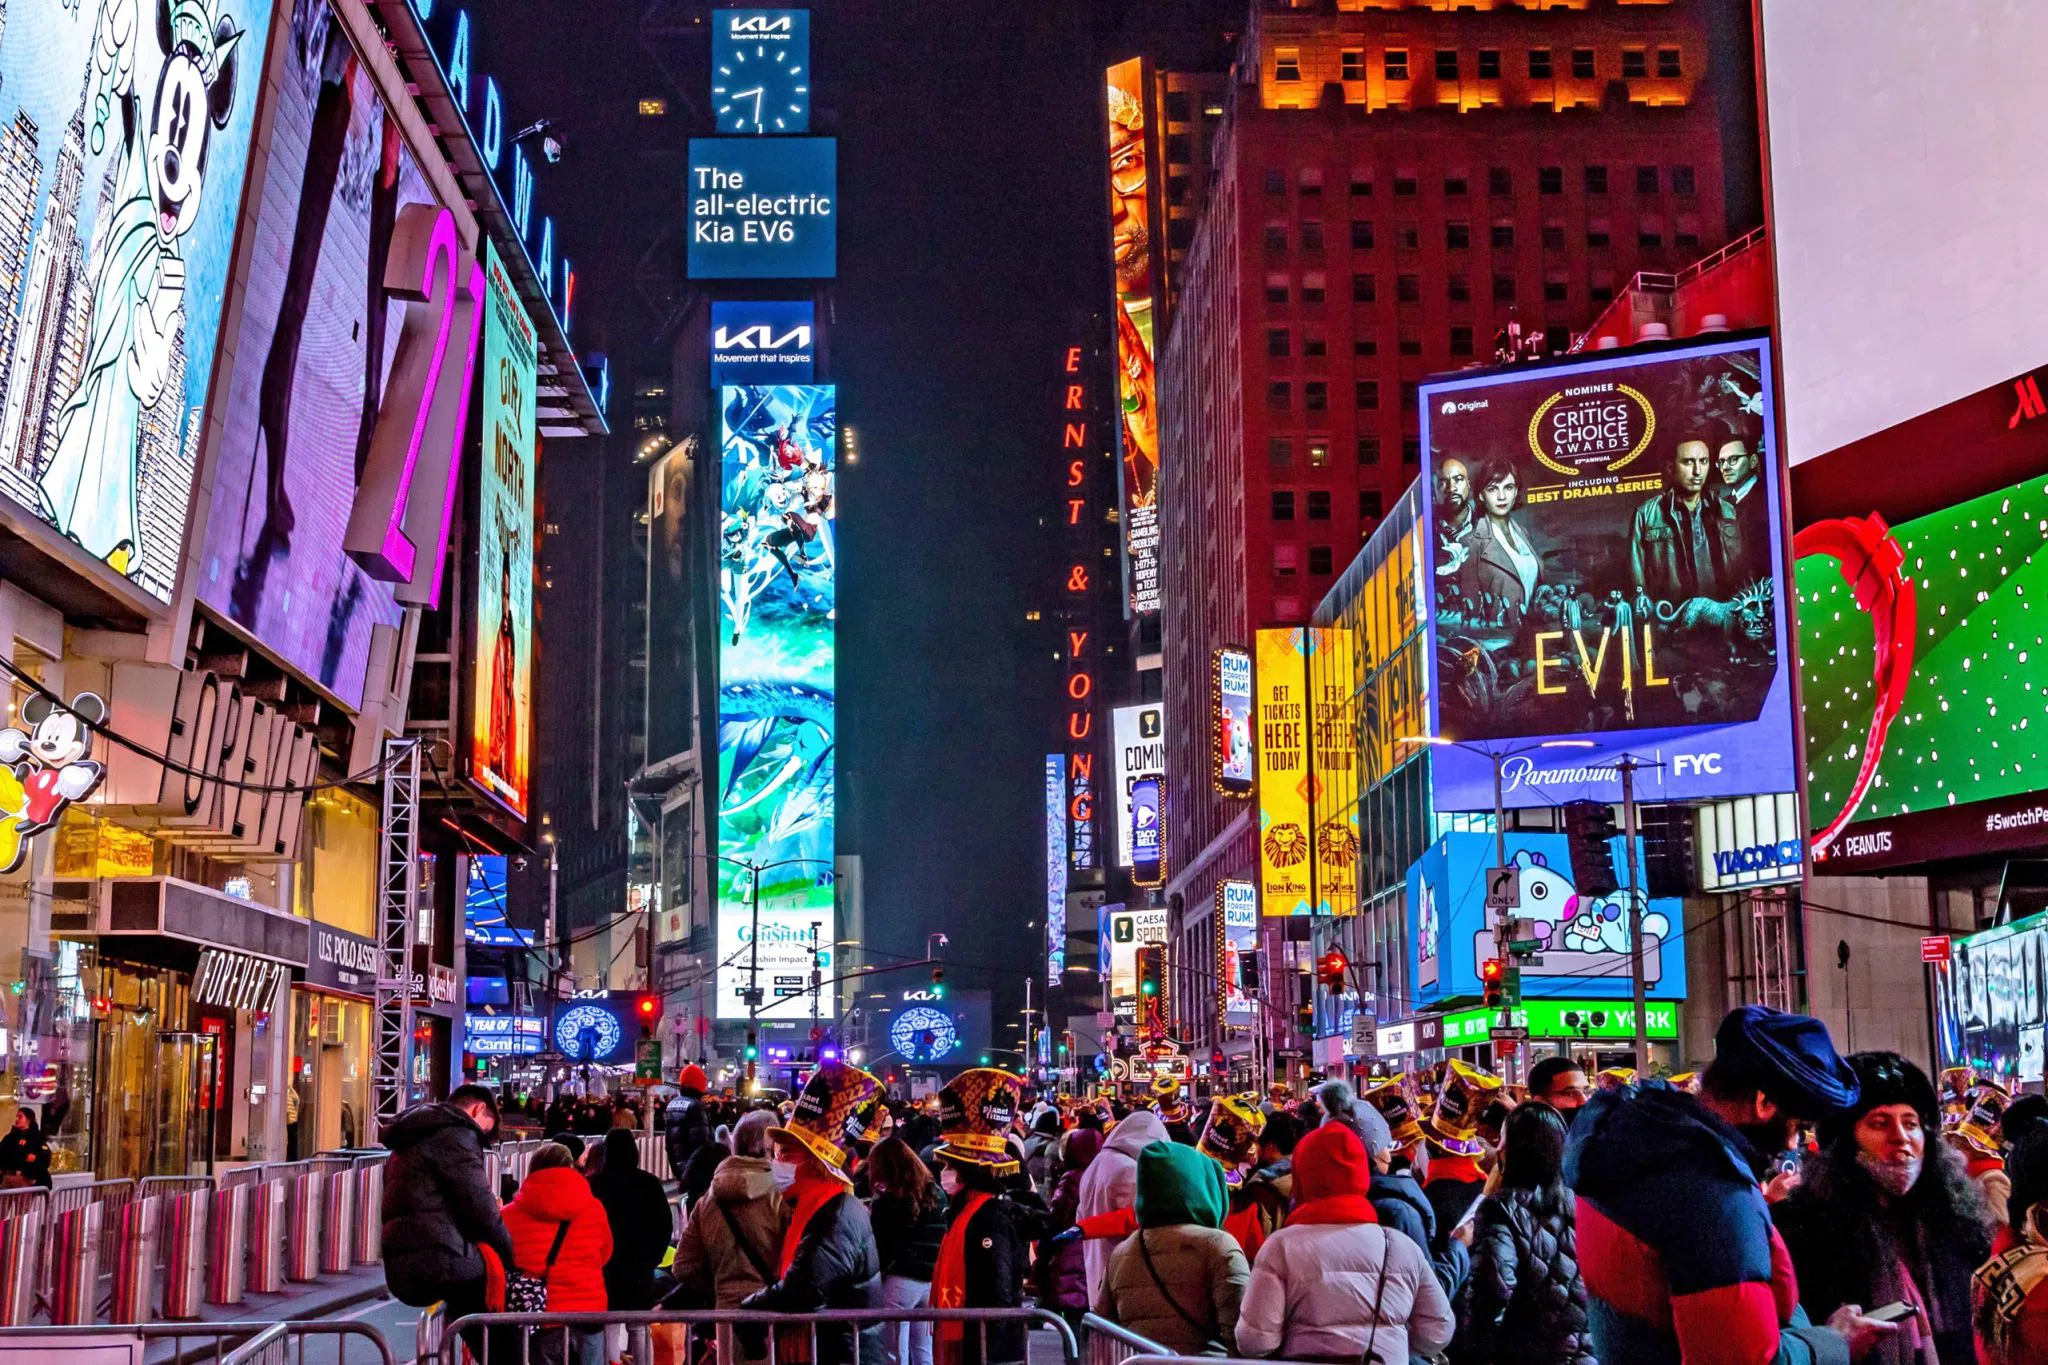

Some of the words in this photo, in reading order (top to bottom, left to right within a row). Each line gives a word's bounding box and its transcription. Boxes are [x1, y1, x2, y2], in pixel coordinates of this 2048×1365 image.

[731, 16, 791, 31] KIA
[694, 167, 743, 189] The
[694, 193, 831, 216] all-electric
[695, 220, 735, 243] Kia
[743, 220, 794, 243] EV6
[714, 325, 811, 349] KIA
[714, 353, 759, 363] Movement
[760, 353, 778, 362] that
[1565, 383, 1614, 397] NOMINEE
[499, 356, 524, 442] GIRL
[1458, 400, 1489, 412] Original
[1553, 404, 1628, 428] CRITICS
[1064, 347, 1086, 525] ERNST
[1554, 421, 1629, 445] CHOICE
[1554, 437, 1629, 455] AWARDS
[494, 418, 526, 512] NORTH
[1568, 476, 1619, 489] INCLUDING
[1527, 491, 1560, 504] BEST
[1563, 486, 1613, 501] DRAMA
[1615, 479, 1663, 494] SERIES
[1138, 547, 1153, 559] CALL
[1067, 566, 1089, 592] &
[1143, 578, 1157, 590] TEXT
[1223, 656, 1249, 674] RUM
[1535, 624, 1670, 714] EVIL
[1223, 671, 1249, 682] FORREST
[1223, 680, 1249, 693] RUM!
[1273, 685, 1290, 702] GET
[1264, 703, 1301, 721] TICKETS
[1069, 632, 1093, 822] YOUNG
[1264, 722, 1301, 749] HERE
[1266, 751, 1301, 771] TODAY
[1500, 757, 1638, 793] Paramount
[1673, 752, 1723, 776] FYC
[1136, 829, 1157, 838] TACO
[1137, 836, 1157, 847] BELL
[1846, 832, 1892, 858] PEANUTS
[1227, 887, 1254, 902] RUM
[1266, 882, 1284, 894] LION
[1285, 882, 1307, 894] KING
[1227, 901, 1254, 911] FORREST
[1492, 896, 1516, 905] ONLY
[1136, 914, 1168, 925] CAESA
[1227, 910, 1254, 923] RUM!
[737, 925, 814, 942] GNSHIN
[318, 931, 333, 962] U.S.
[334, 935, 357, 968] POLO
[742, 955, 776, 963] Geshin
[779, 955, 808, 964] Impact
[197, 949, 268, 1011] FOREVER
[262, 964, 286, 1014] 21
[395, 974, 424, 983] PLO
[474, 1019, 496, 1031] YEAR
[496, 1019, 509, 1031] OF
[475, 1037, 526, 1051] Carnial
[1356, 1031, 1375, 1043] 25
[800, 1099, 823, 1114] tness
[801, 1094, 820, 1105] anet
[982, 1104, 1009, 1115] planet
[986, 1109, 1012, 1122] fitness
